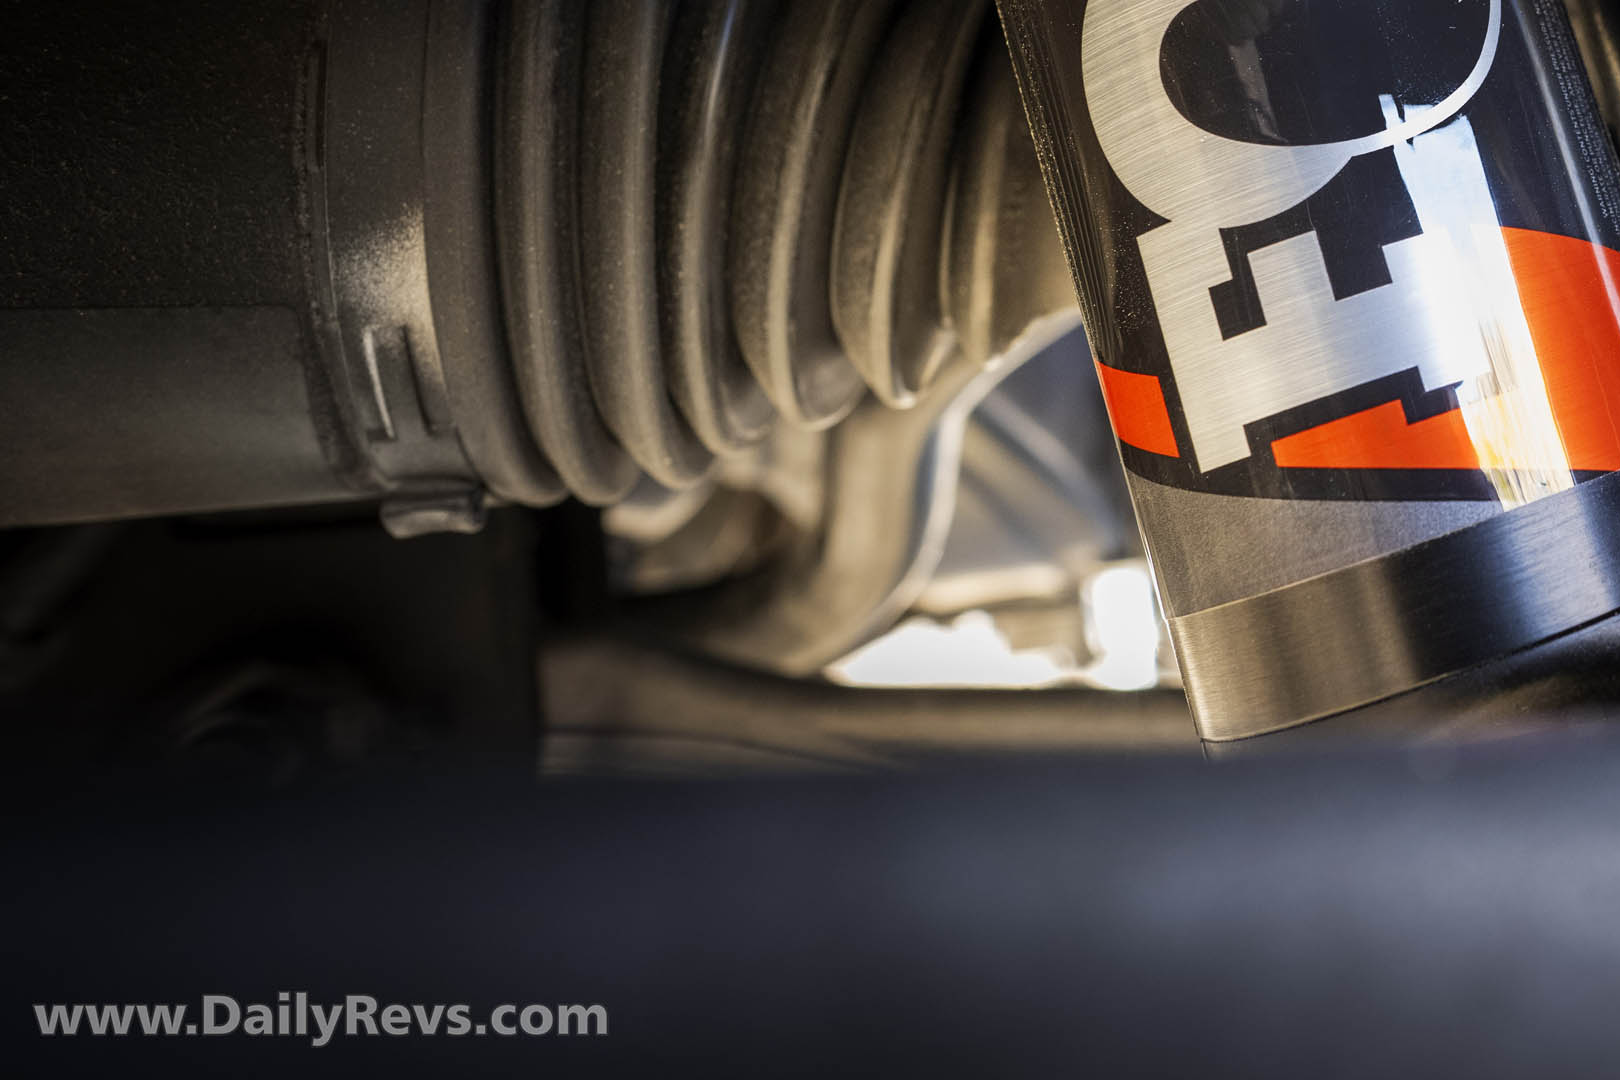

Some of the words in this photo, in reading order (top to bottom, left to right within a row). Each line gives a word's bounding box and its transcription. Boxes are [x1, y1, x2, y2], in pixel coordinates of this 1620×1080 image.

[1555, 72, 1572, 107] UNDER
[1568, 109, 1591, 162] CONTENTS
[1586, 164, 1609, 218] WARNING!
